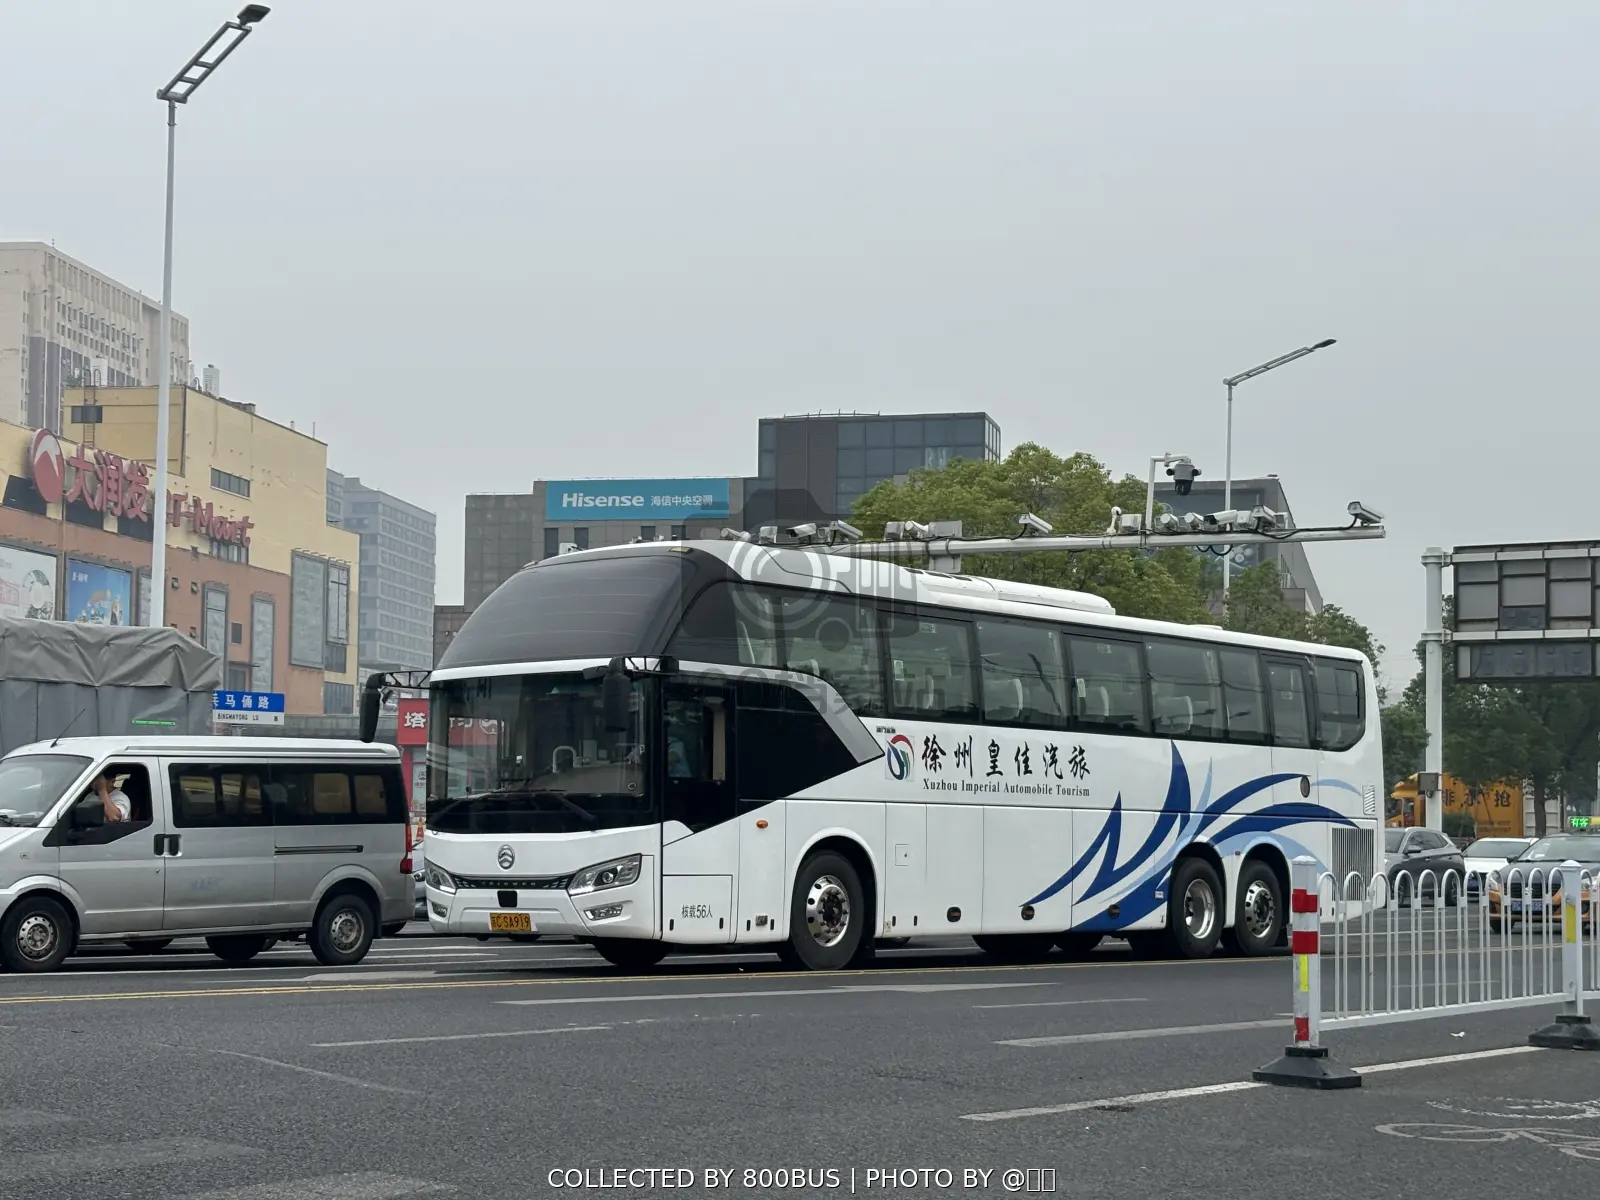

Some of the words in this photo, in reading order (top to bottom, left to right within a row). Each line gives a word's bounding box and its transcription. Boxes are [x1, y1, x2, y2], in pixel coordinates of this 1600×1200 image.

[67, 444, 150, 522] 大润发
[562, 493, 645, 508] Hisense
[650, 494, 713, 506] 海信中央空调
[921, 734, 1090, 780] 徐州皇佳汽旅
[923, 778, 958, 791] Xuzhou
[961, 780, 1000, 794] Imperial
[1003, 782, 1052, 795] Automobile
[1056, 784, 1090, 797] Tourism
[682, 904, 713, 919] 核载56人
